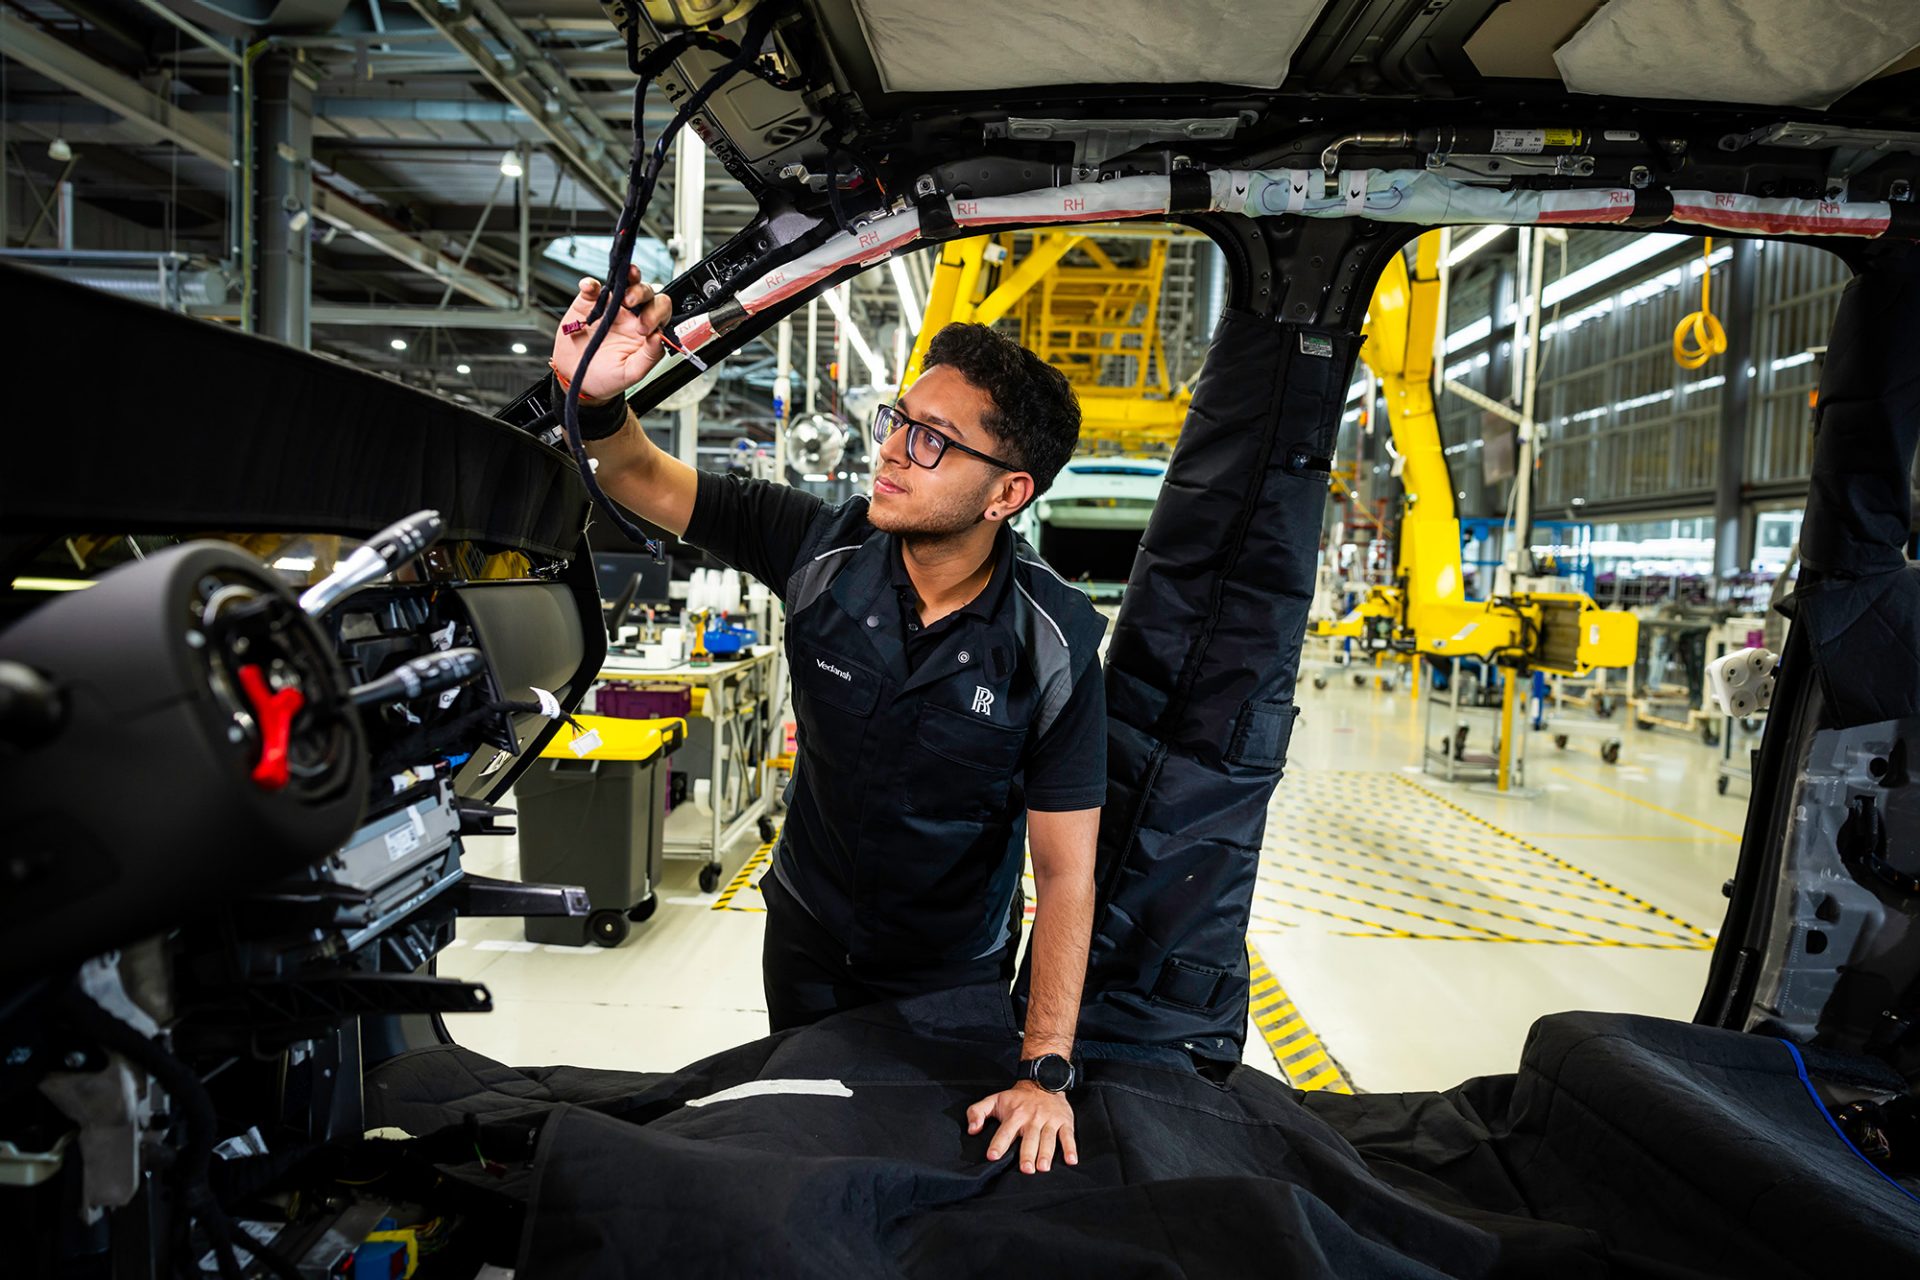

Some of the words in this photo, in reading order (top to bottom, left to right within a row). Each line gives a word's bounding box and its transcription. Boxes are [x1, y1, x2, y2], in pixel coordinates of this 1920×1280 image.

[1609, 191, 1630, 204] RH
[1715, 194, 1736, 208] RH
[957, 202, 978, 215] RH
[1063, 198, 1085, 211] RH
[1818, 201, 1841, 214] RH
[858, 231, 881, 249] RH
[765, 272, 786, 289] RH
[816, 658, 852, 682] Vedansh
